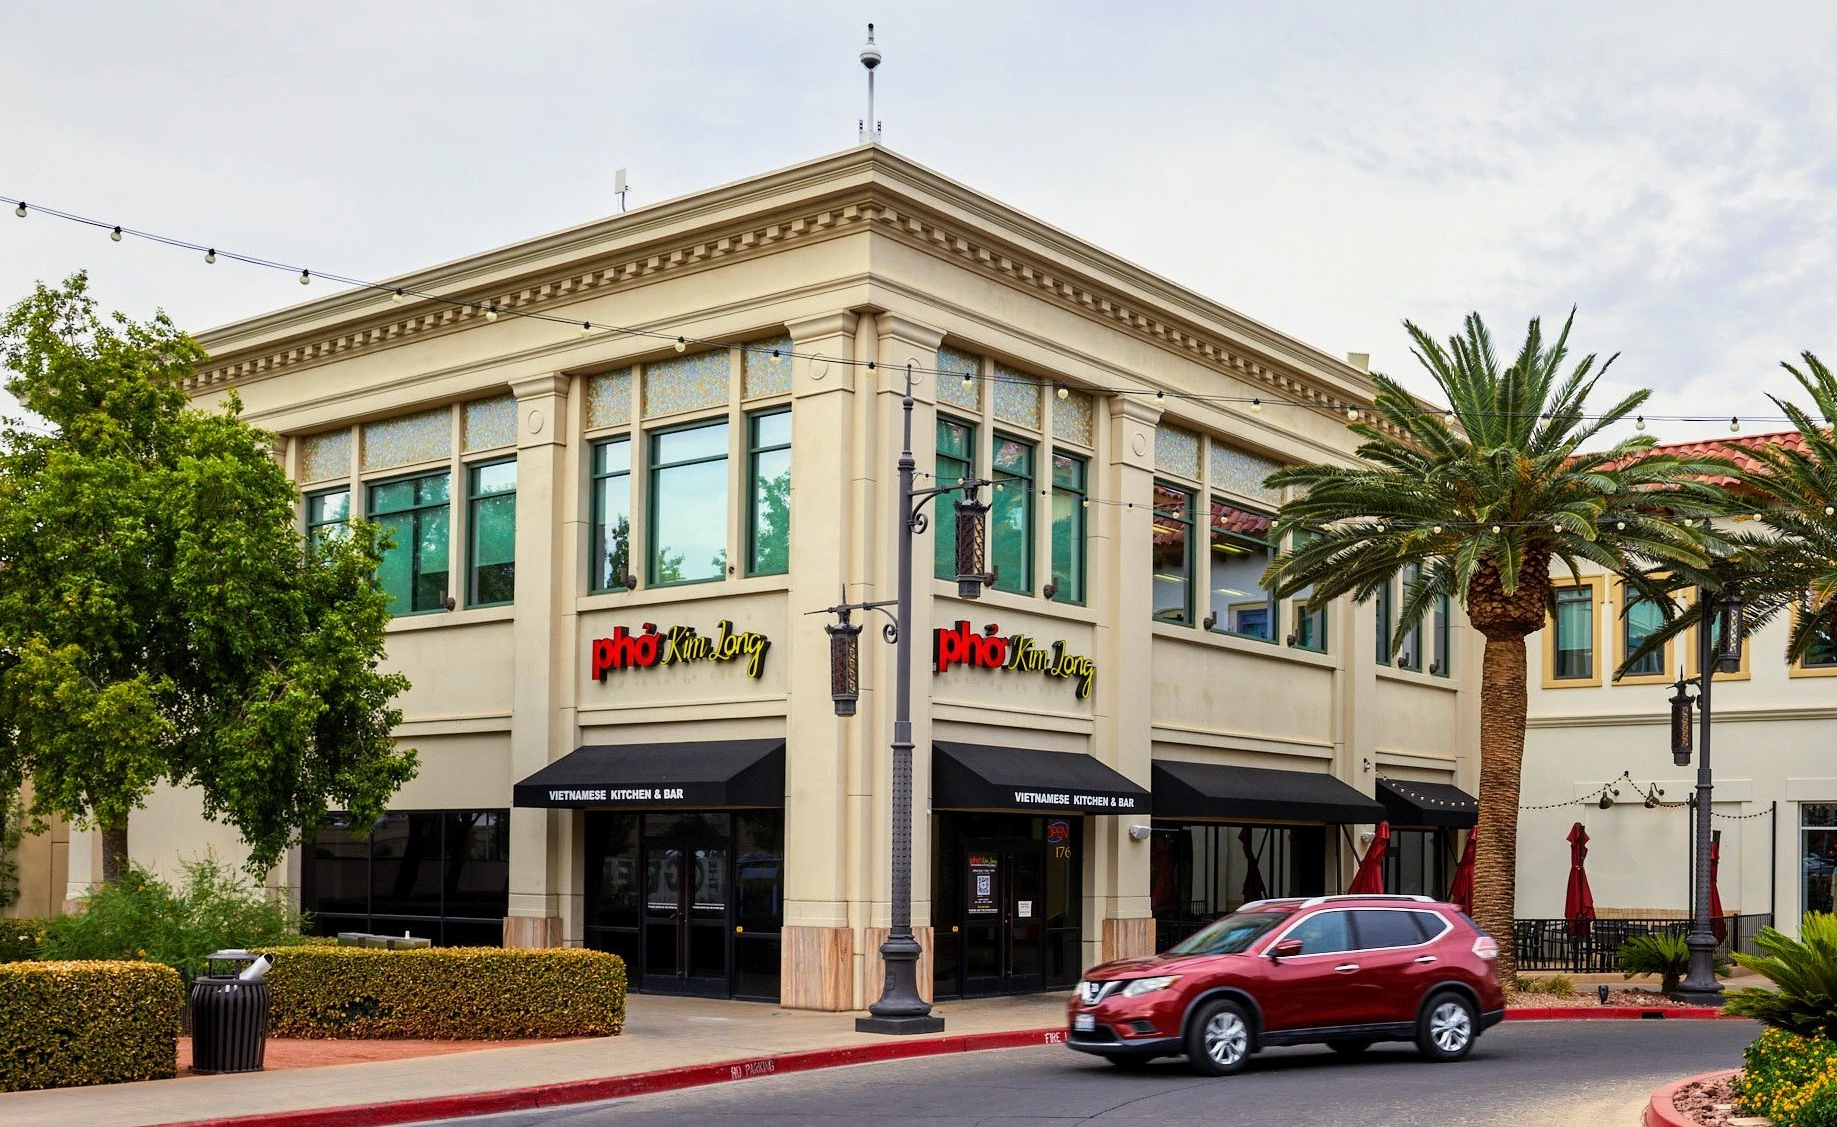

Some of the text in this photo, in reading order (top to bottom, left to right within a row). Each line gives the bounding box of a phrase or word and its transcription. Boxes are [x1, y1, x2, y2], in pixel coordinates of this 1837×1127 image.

[661, 625, 708, 665] Kim
[709, 619, 767, 678] Long
[1006, 633, 1050, 672] Kim
[1050, 639, 1097, 699] Long
[549, 788, 684, 801] VIETNAMESE KITCHEN & BAR
[1015, 792, 1135, 808] VIETNAMESE KITCHEN & BAR
[1056, 846, 1072, 859] 176
[1044, 1031, 1062, 1044] FIRE
[730, 1060, 775, 1080] NO PARKING
